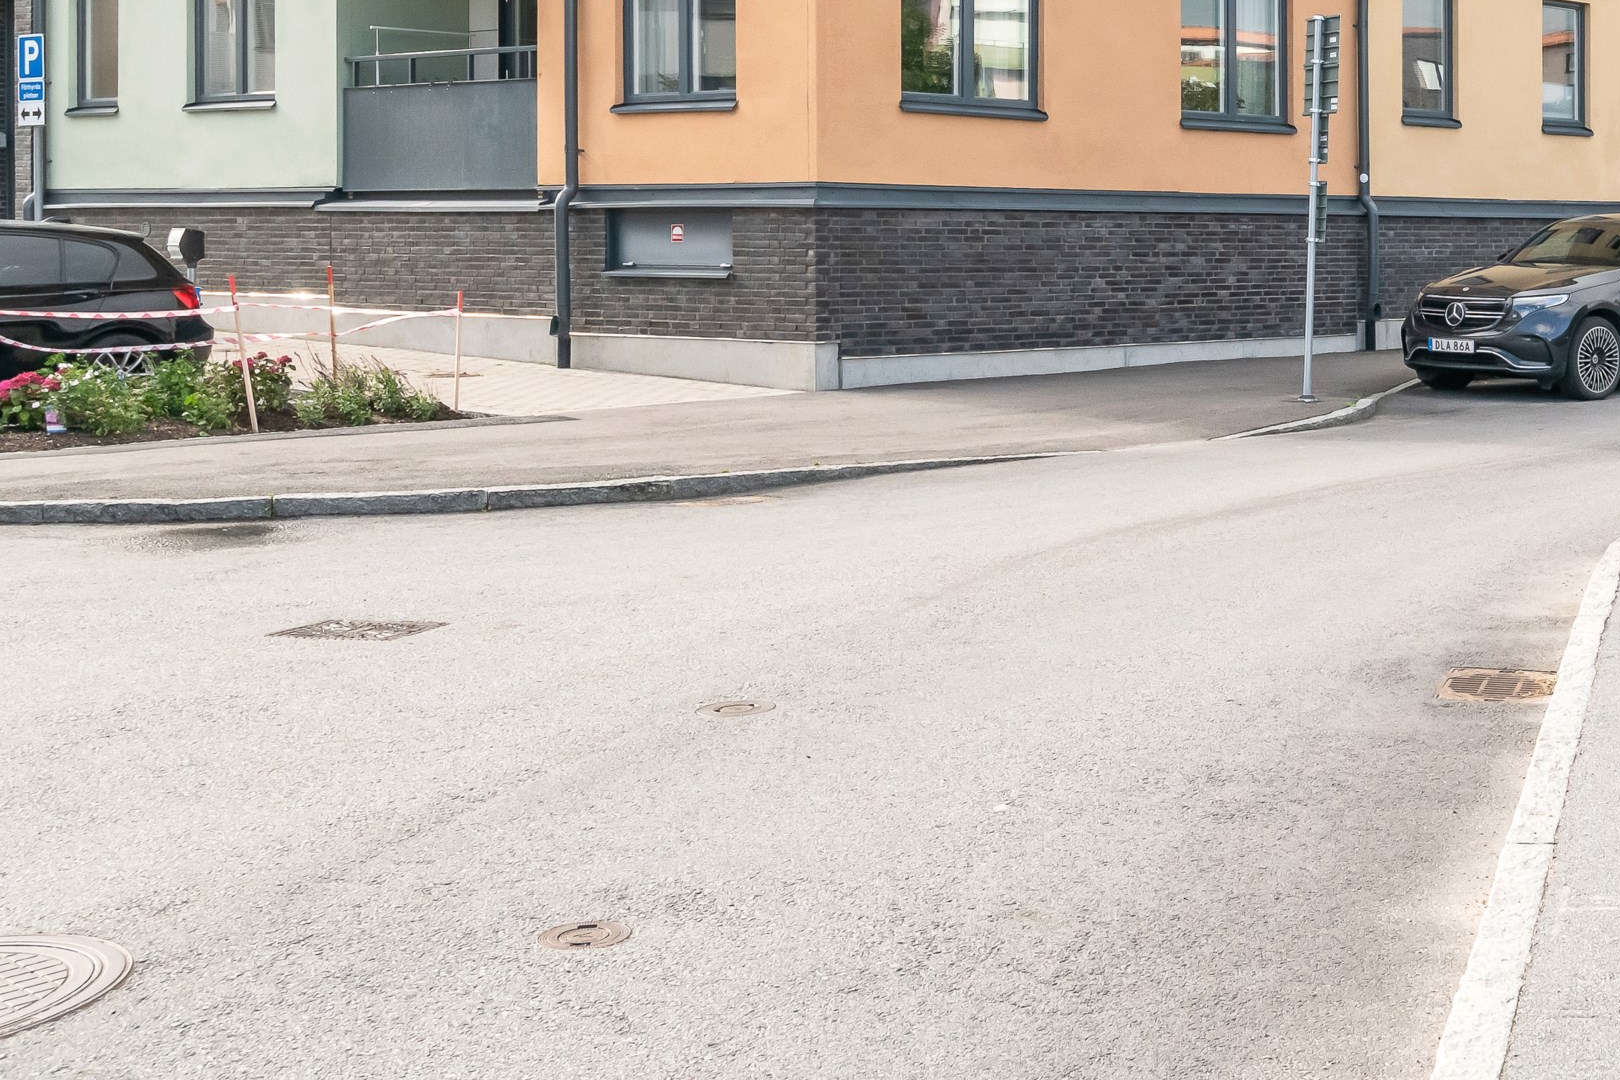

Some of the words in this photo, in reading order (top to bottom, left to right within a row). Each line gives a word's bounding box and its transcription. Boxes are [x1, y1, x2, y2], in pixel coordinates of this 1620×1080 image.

[24, 40, 39, 75] P
[1435, 339, 1451, 351] DLA
[1453, 341, 1470, 352] 86A
